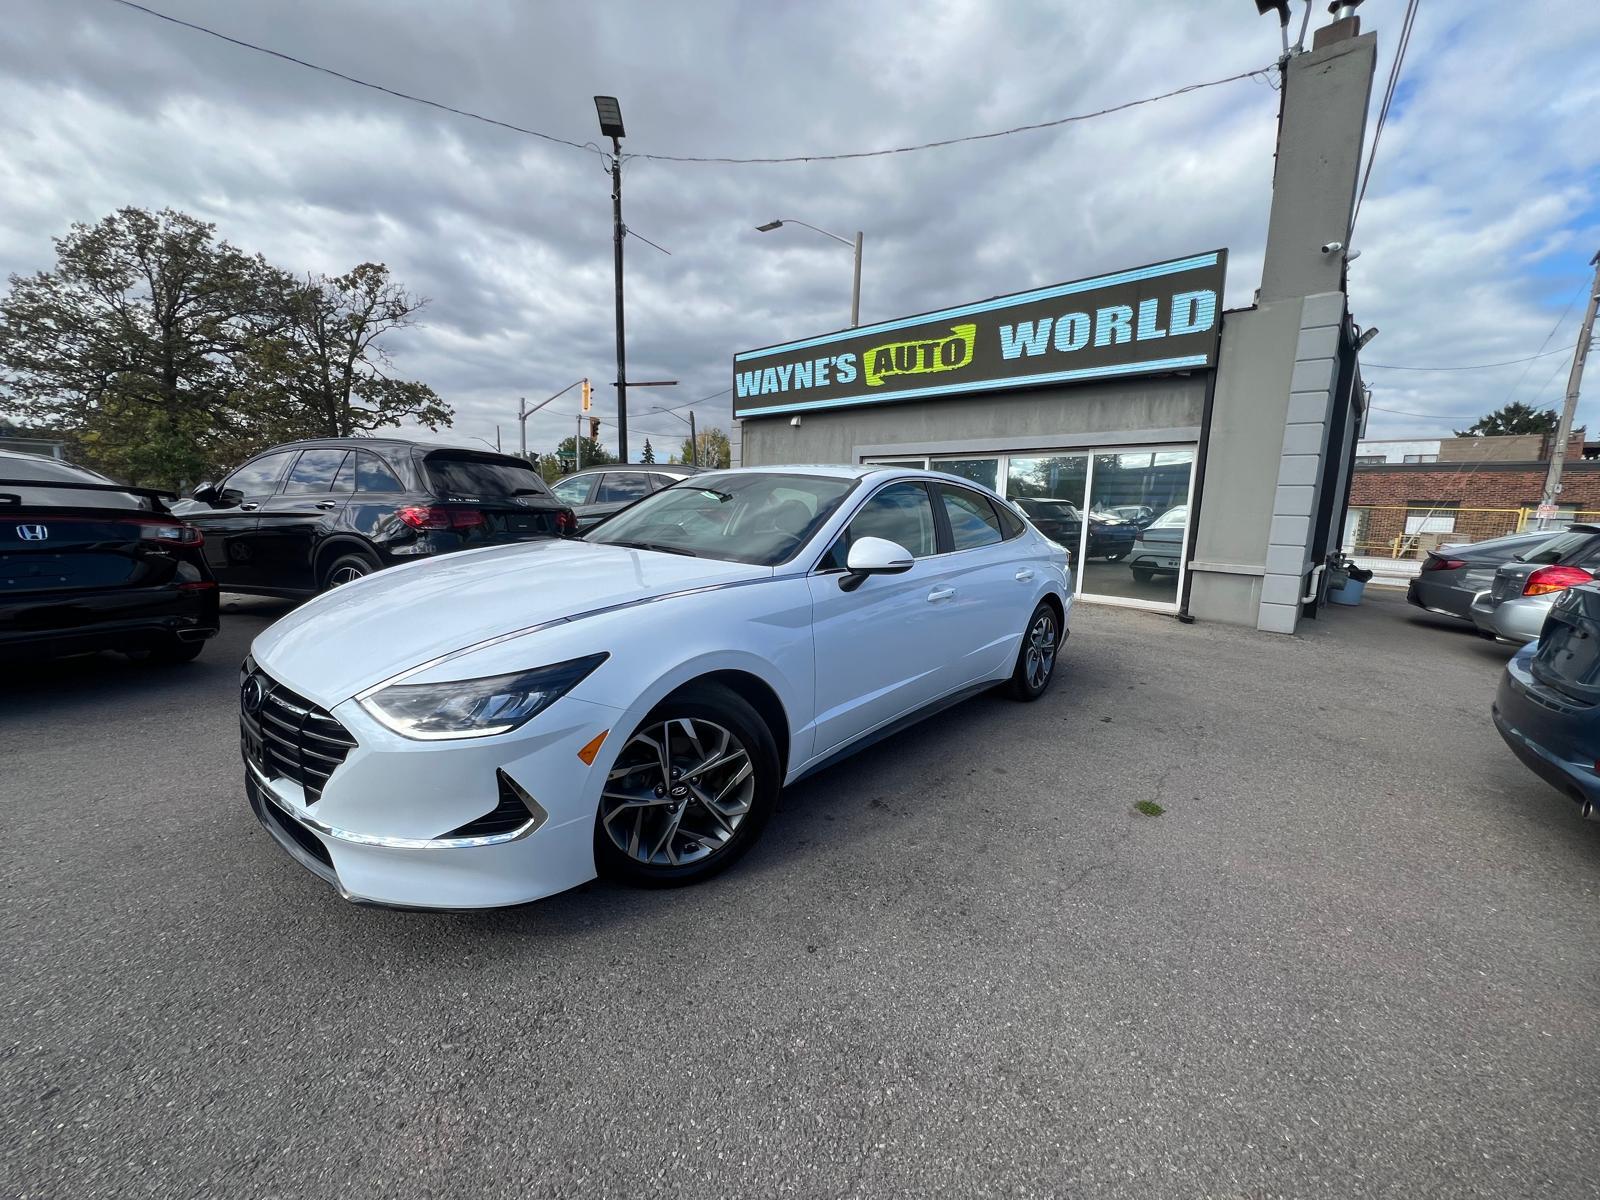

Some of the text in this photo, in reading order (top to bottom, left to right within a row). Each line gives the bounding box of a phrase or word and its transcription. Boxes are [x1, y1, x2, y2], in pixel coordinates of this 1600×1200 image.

[735, 289, 1217, 398] WAYNE'S AUTO WORLD
